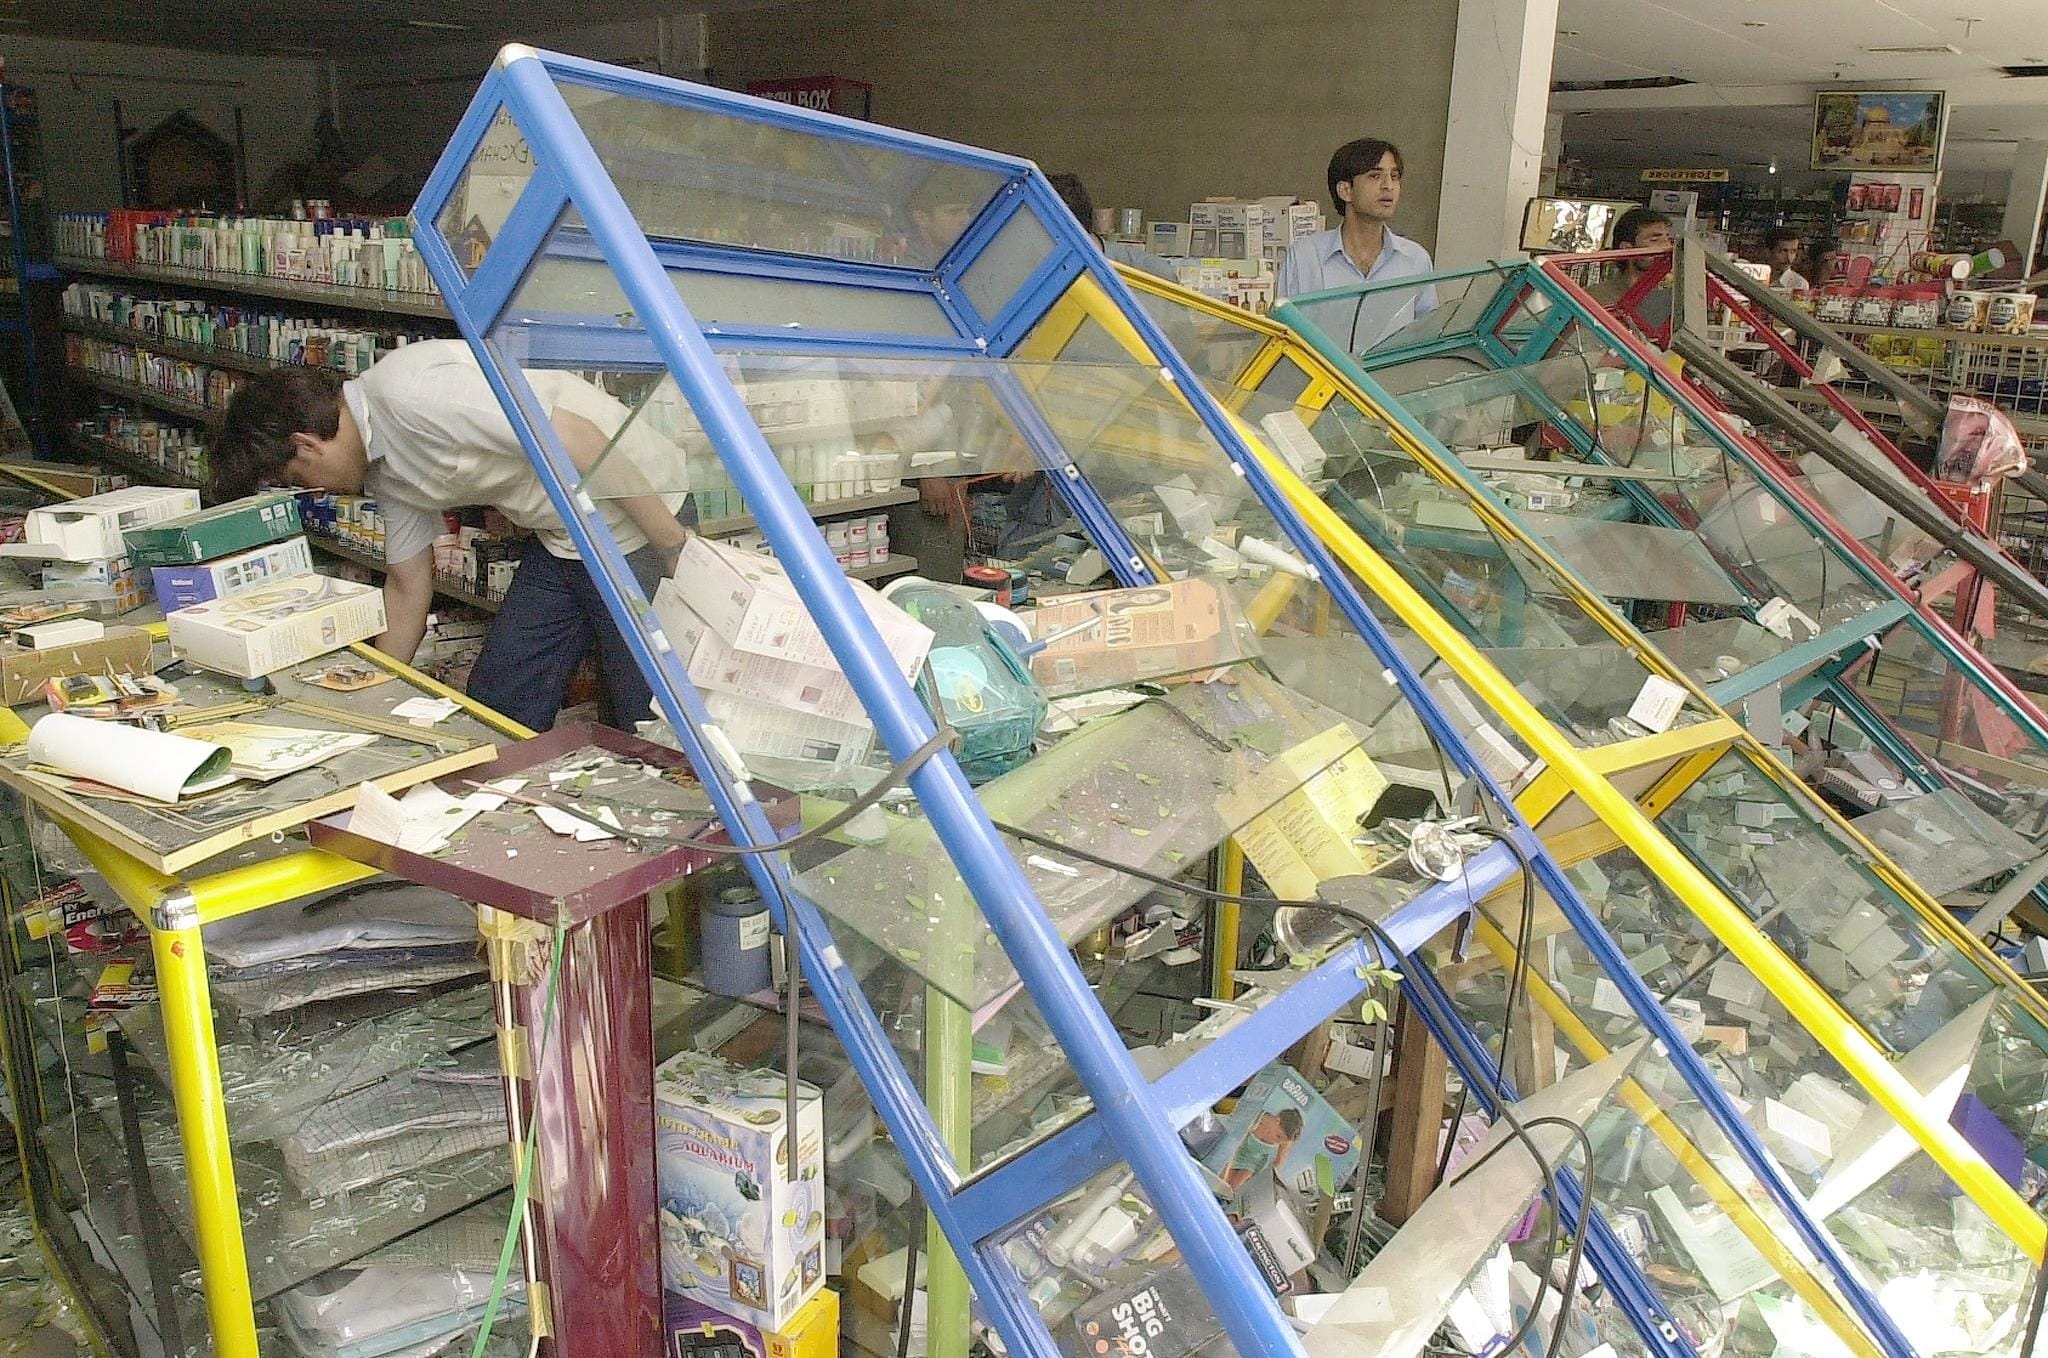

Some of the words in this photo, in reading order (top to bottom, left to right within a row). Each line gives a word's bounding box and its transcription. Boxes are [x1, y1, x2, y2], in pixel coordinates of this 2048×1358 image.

[681, 1140, 756, 1173] AQUARIUM
[1248, 1228, 1283, 1285] REMINGTON
[1131, 1290, 1164, 1338] BIG
